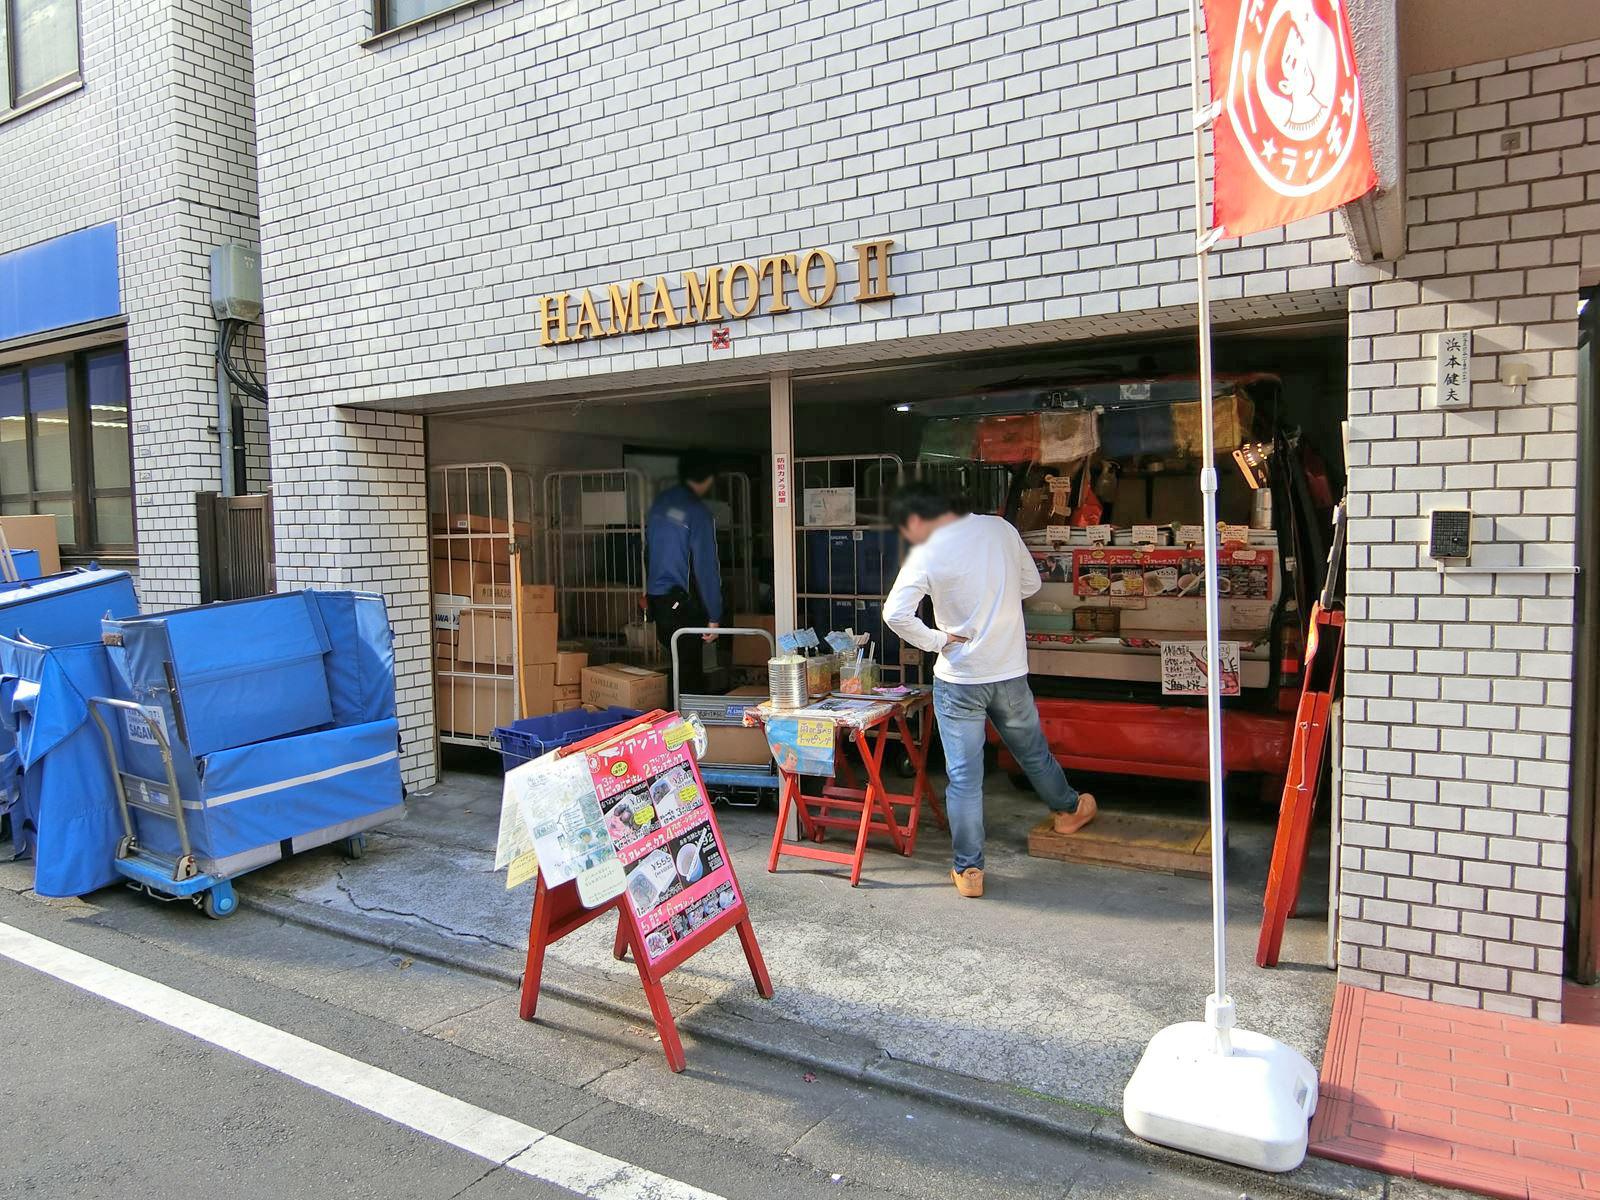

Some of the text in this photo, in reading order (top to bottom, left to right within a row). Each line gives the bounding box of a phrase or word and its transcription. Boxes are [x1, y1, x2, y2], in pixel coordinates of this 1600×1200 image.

[538, 248, 838, 346] HAMAMOTO
[1444, 337, 1461, 402] 浜本健夫
[776, 457, 786, 504] 防犯カメラ設置
